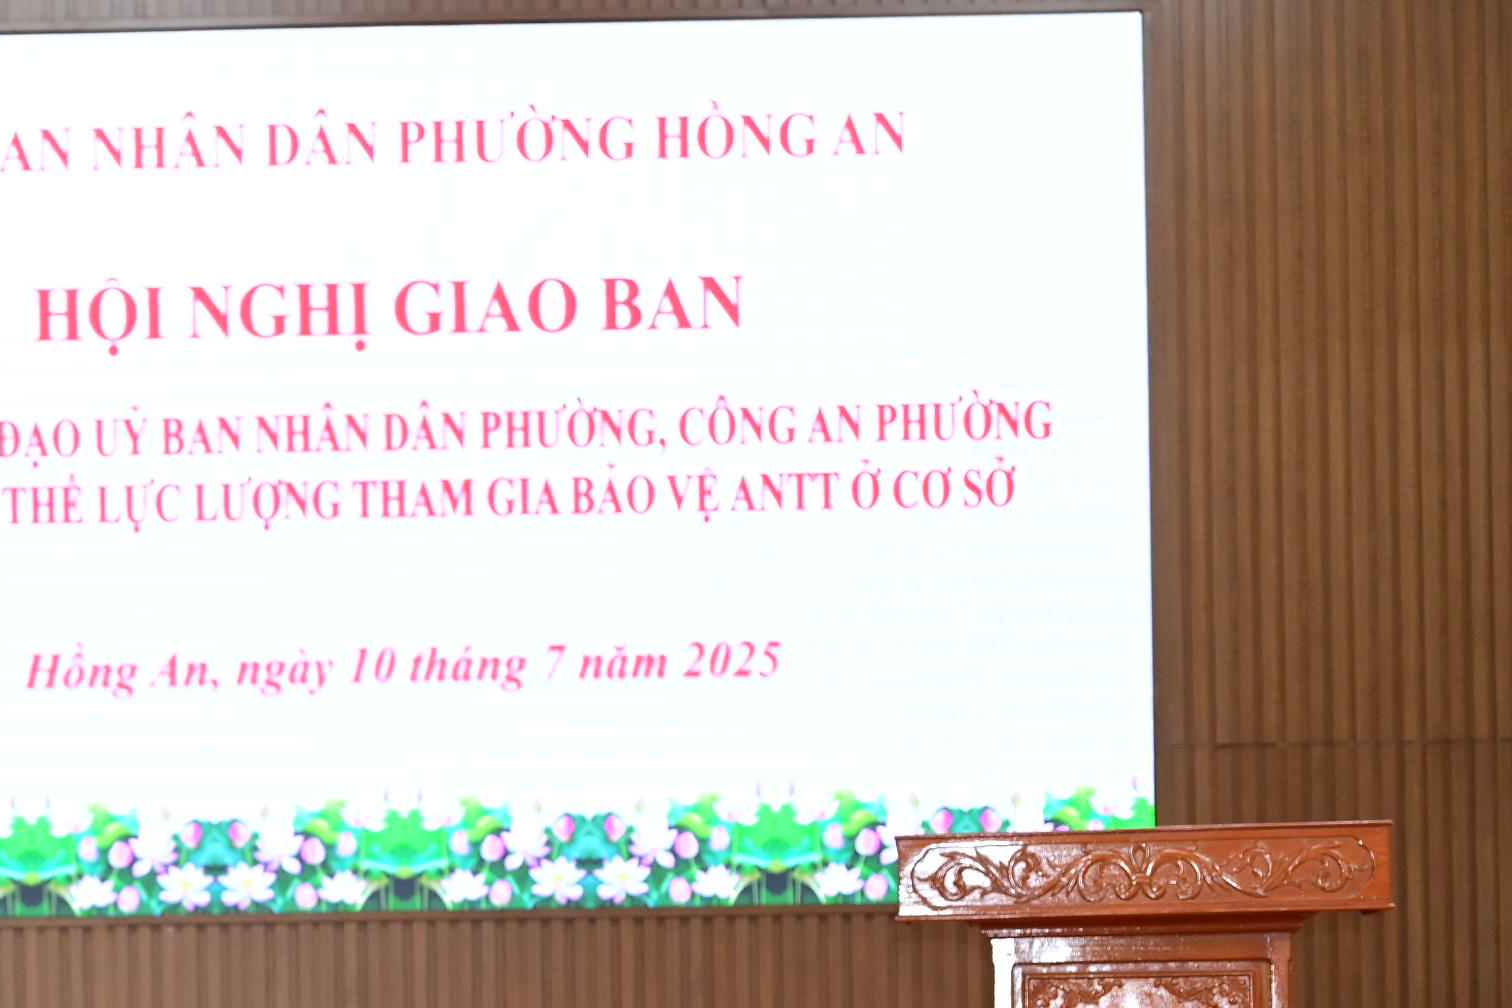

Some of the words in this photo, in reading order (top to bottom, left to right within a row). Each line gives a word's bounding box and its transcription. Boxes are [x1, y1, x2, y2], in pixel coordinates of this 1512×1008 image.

[92, 111, 245, 171] NHÂN
[267, 107, 377, 167] DÂN
[399, 103, 635, 164] PHƯỜNG
[833, 111, 905, 156] AN
[35, 277, 164, 358] HỘI
[188, 281, 371, 353] NGHỊ
[393, 277, 578, 337] GIAO
[601, 274, 744, 332] BAN
[95, 405, 148, 457] UỶ
[161, 415, 241, 456] BAN
[255, 401, 369, 454] NHÂN
[382, 399, 466, 452] DÂN
[480, 396, 667, 450] PHƯỜNG,
[677, 394, 797, 447] CÔNG
[807, 404, 861, 444] AN
[875, 388, 1053, 443] PHƯỜNG
[97, 478, 181, 534] LỰC
[194, 476, 341, 532] LƯỢNG
[351, 477, 475, 519] THAM
[486, 476, 561, 517] GIA
[571, 463, 657, 516] BẢO
[666, 467, 720, 524] VỆ
[730, 471, 840, 512] ANTT
[850, 458, 883, 510] Ở
[892, 466, 953, 510] CƠ
[962, 455, 1017, 509] SỞ
[25, 642, 139, 698] Hồng
[149, 652, 220, 691] An,
[236, 647, 335, 696] ngày
[351, 647, 397, 684] 10
[408, 645, 528, 691] tháng
[547, 643, 567, 679] 7
[578, 645, 668, 681] năm
[682, 639, 782, 679] 2025
